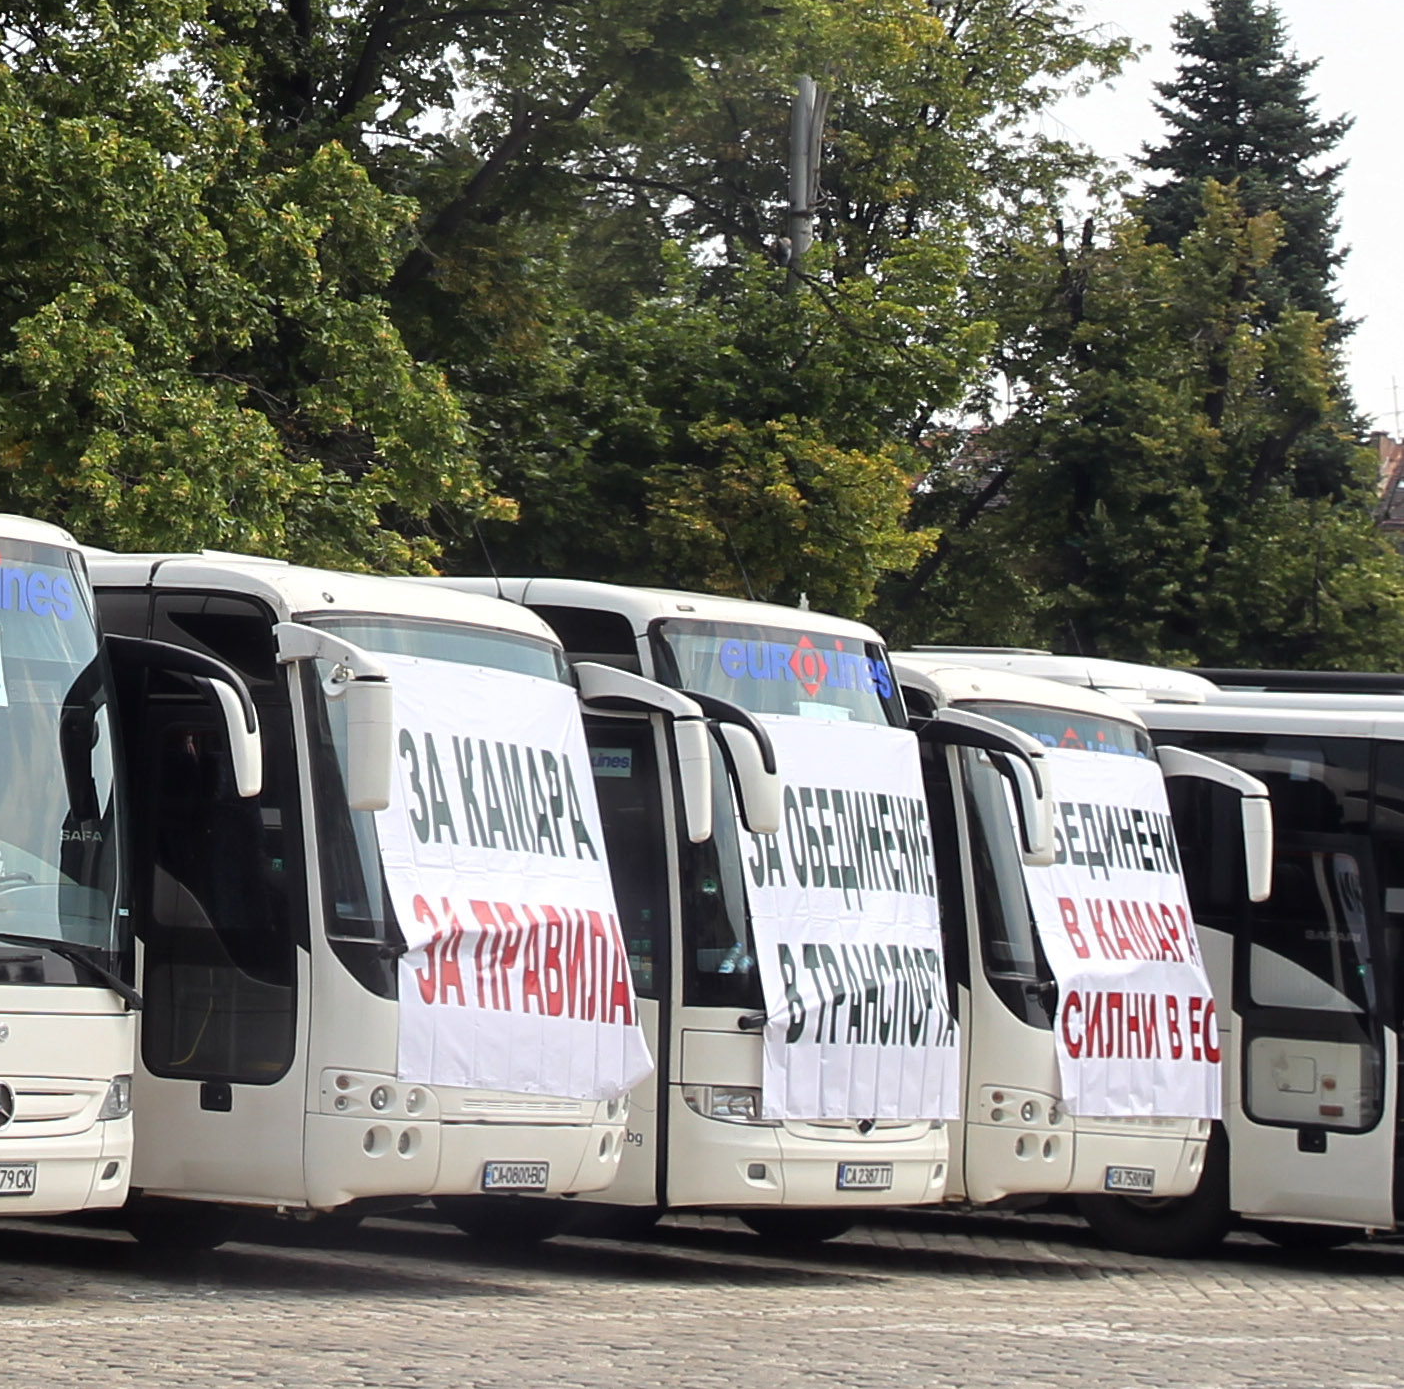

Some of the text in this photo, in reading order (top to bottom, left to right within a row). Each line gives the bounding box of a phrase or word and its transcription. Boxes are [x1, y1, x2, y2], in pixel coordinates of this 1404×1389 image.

[399, 728, 599, 861] ЗА КАМАРА
[784, 785, 935, 910] ОБЕДИНЕНИЕ
[1052, 802, 1180, 881] БЕДИНЕНИ
[413, 894, 466, 1006] ЗА
[1058, 897, 1090, 959] В
[777, 942, 955, 1047] В ТРАНСПОРТА
[1062, 990, 1161, 1060] СИЛНИ
[1165, 995, 1182, 1059] В
[16, 1169, 32, 1188] CK
